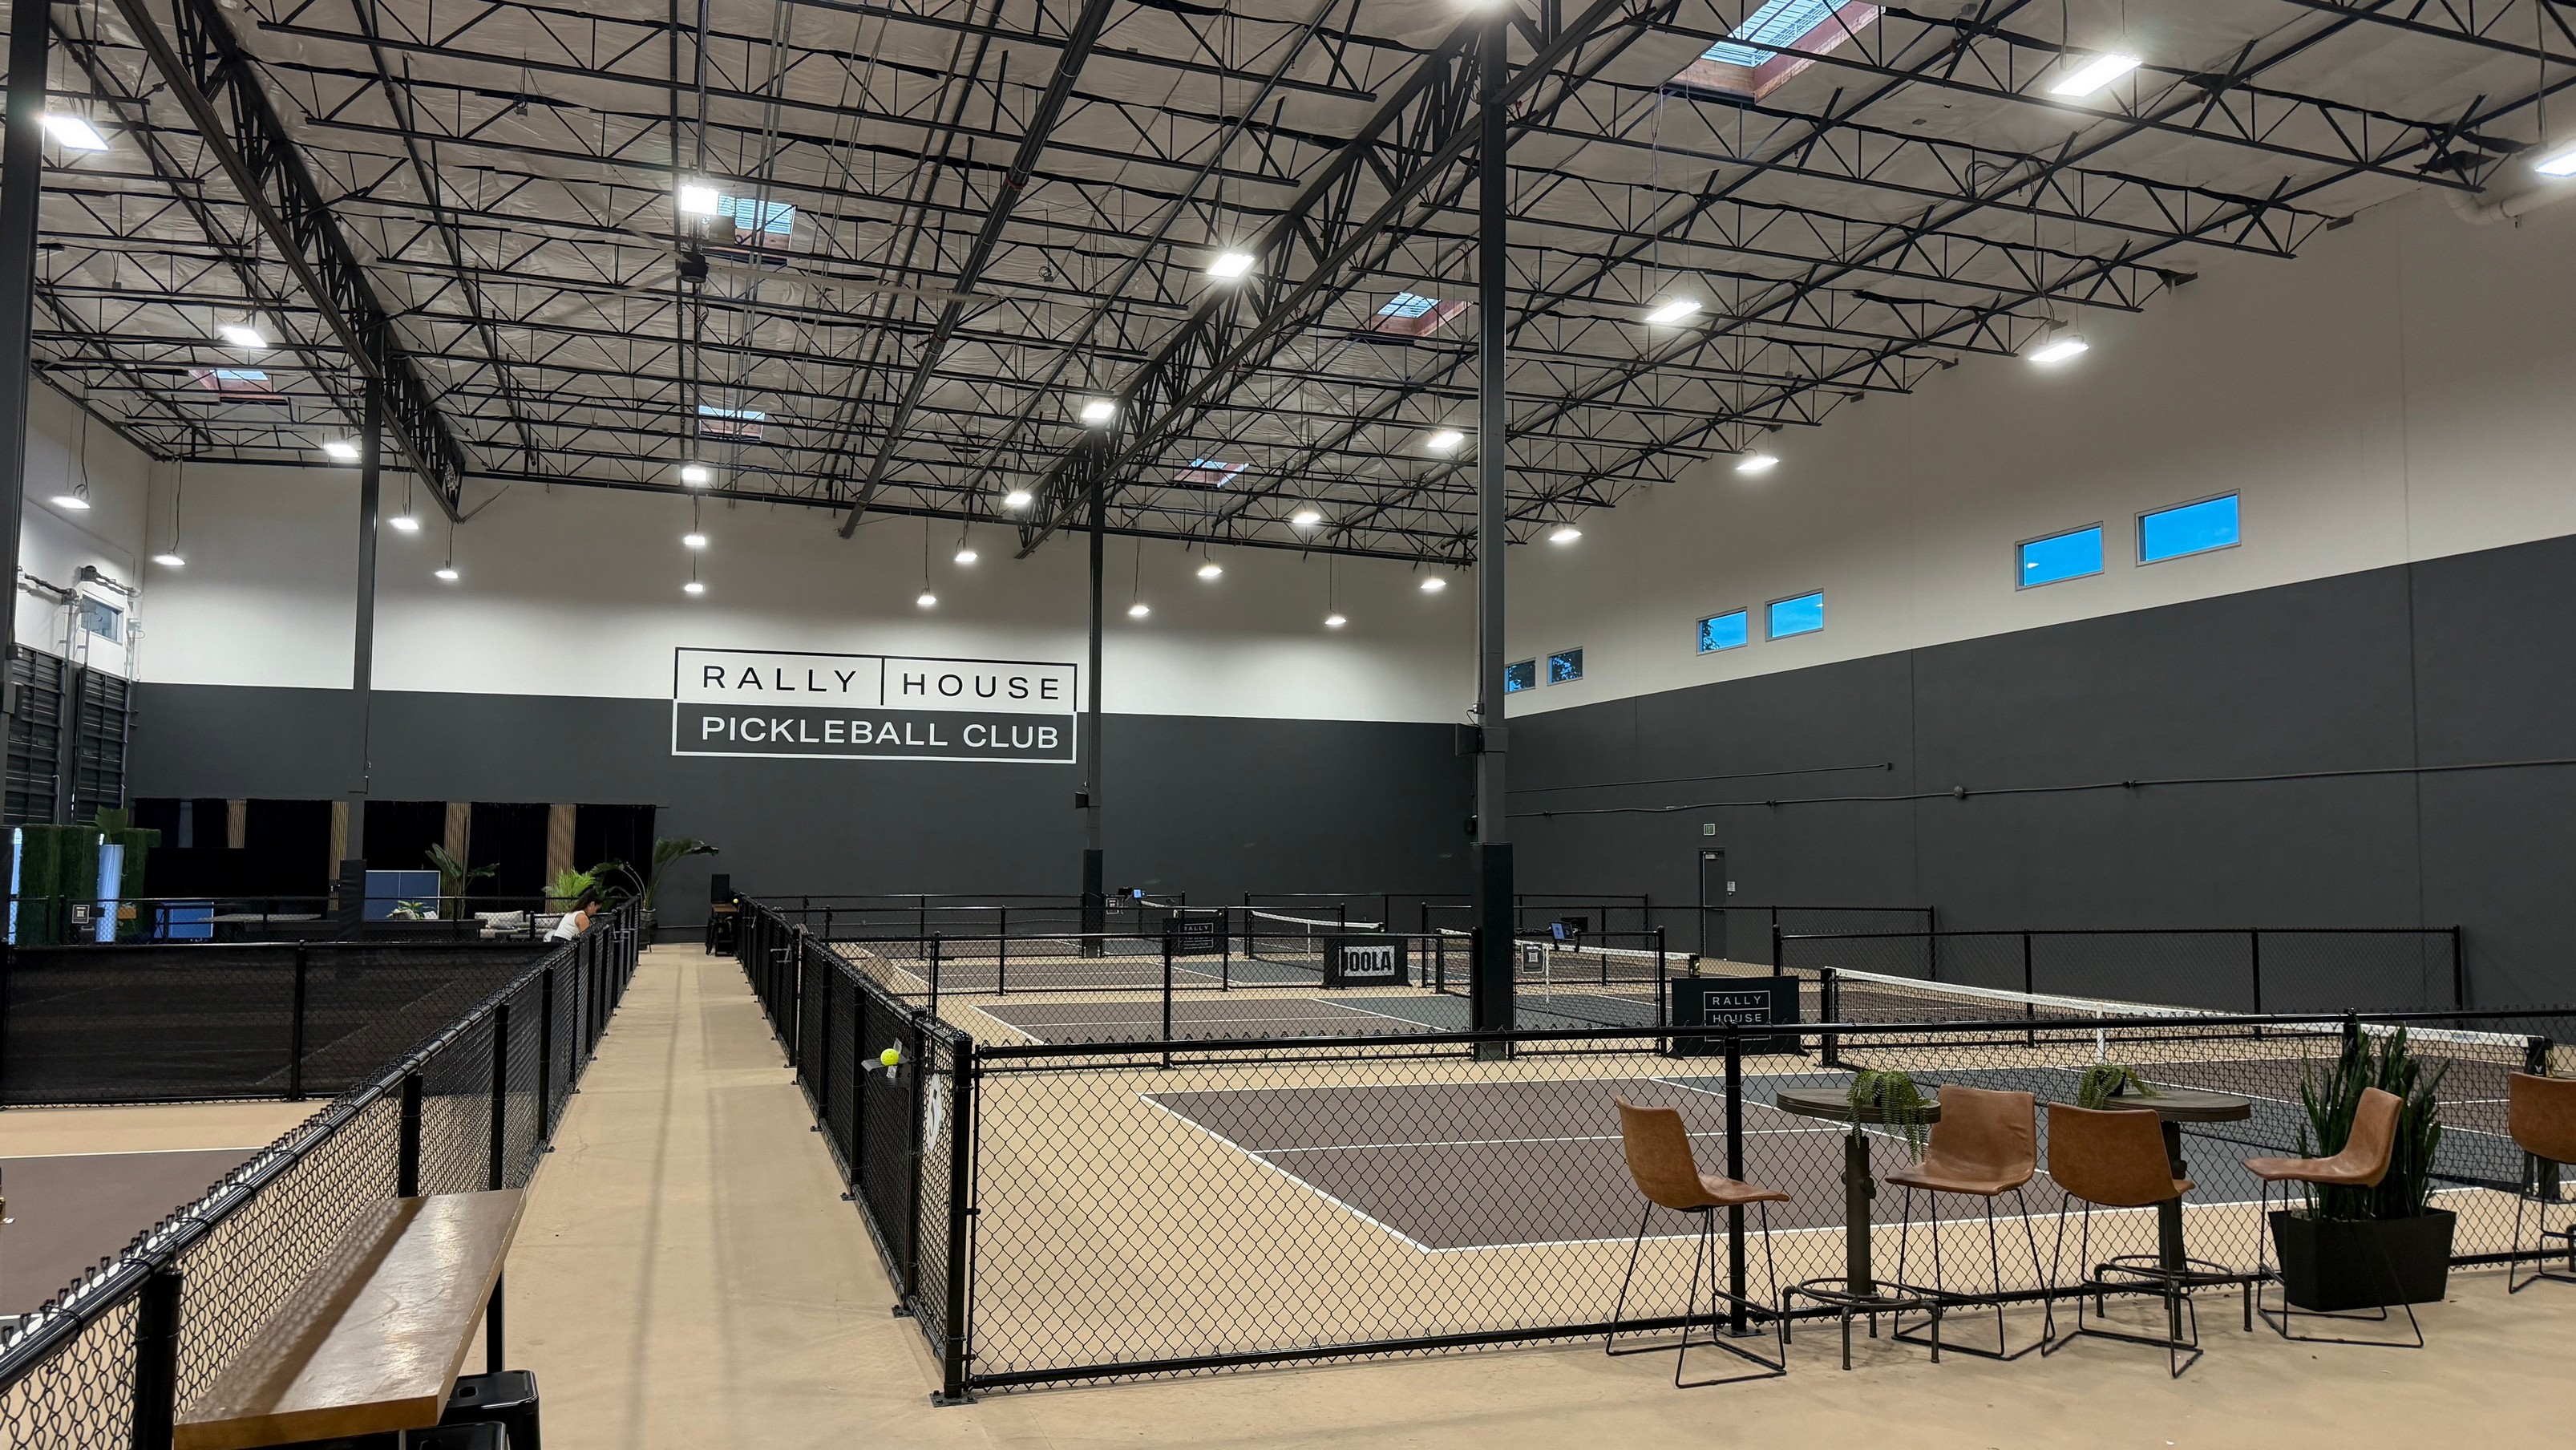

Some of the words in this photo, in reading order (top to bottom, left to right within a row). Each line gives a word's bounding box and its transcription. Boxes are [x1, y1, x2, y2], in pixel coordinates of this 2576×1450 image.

[703, 665, 856, 693] RALLY
[903, 673, 1059, 700] HOUSE
[702, 716, 948, 747] PICKLEBALL
[963, 724, 1058, 749] CLUB
[1713, 996, 1761, 1005] RALLY
